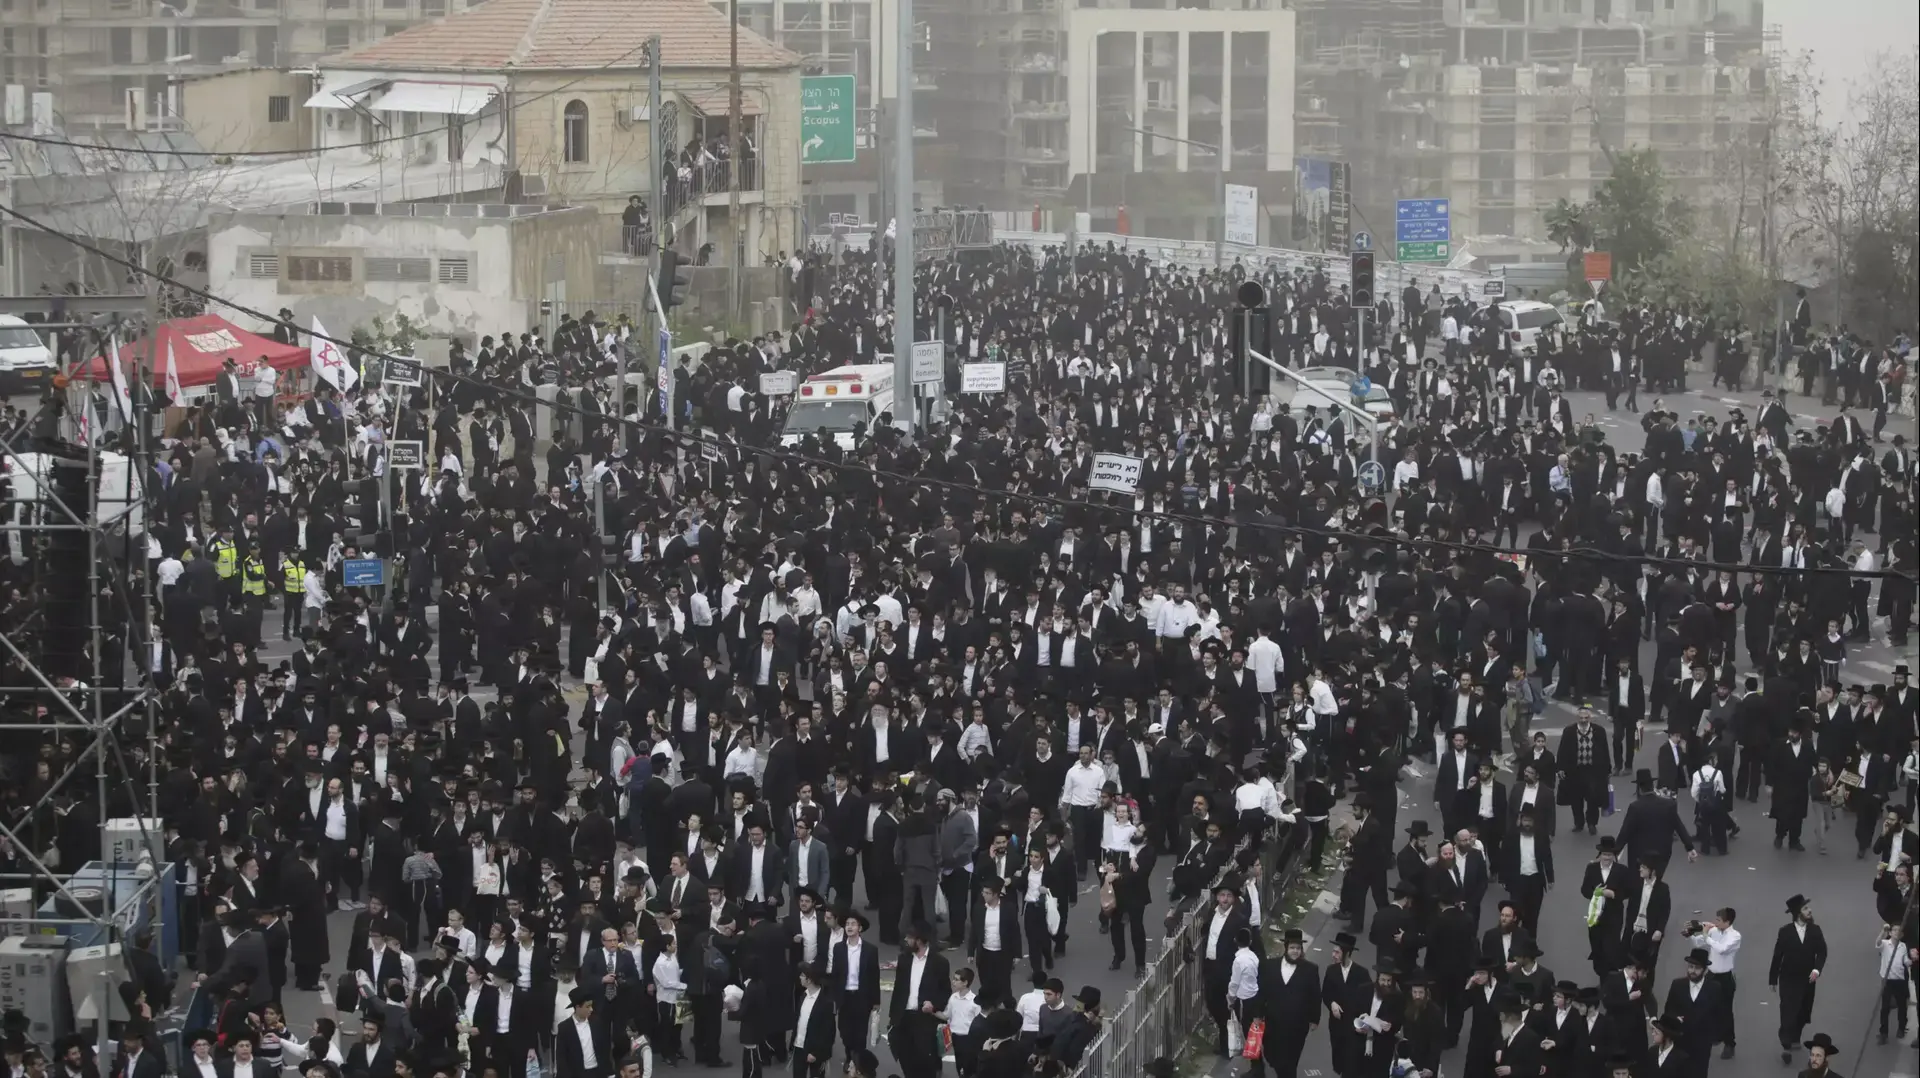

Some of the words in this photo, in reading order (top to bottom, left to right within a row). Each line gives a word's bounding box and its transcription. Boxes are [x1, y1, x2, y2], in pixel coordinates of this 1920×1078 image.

[827, 88, 840, 97] הר
[803, 116, 840, 126] Scopus
[1125, 465, 1138, 473] לא
[1124, 476, 1137, 484] לא
